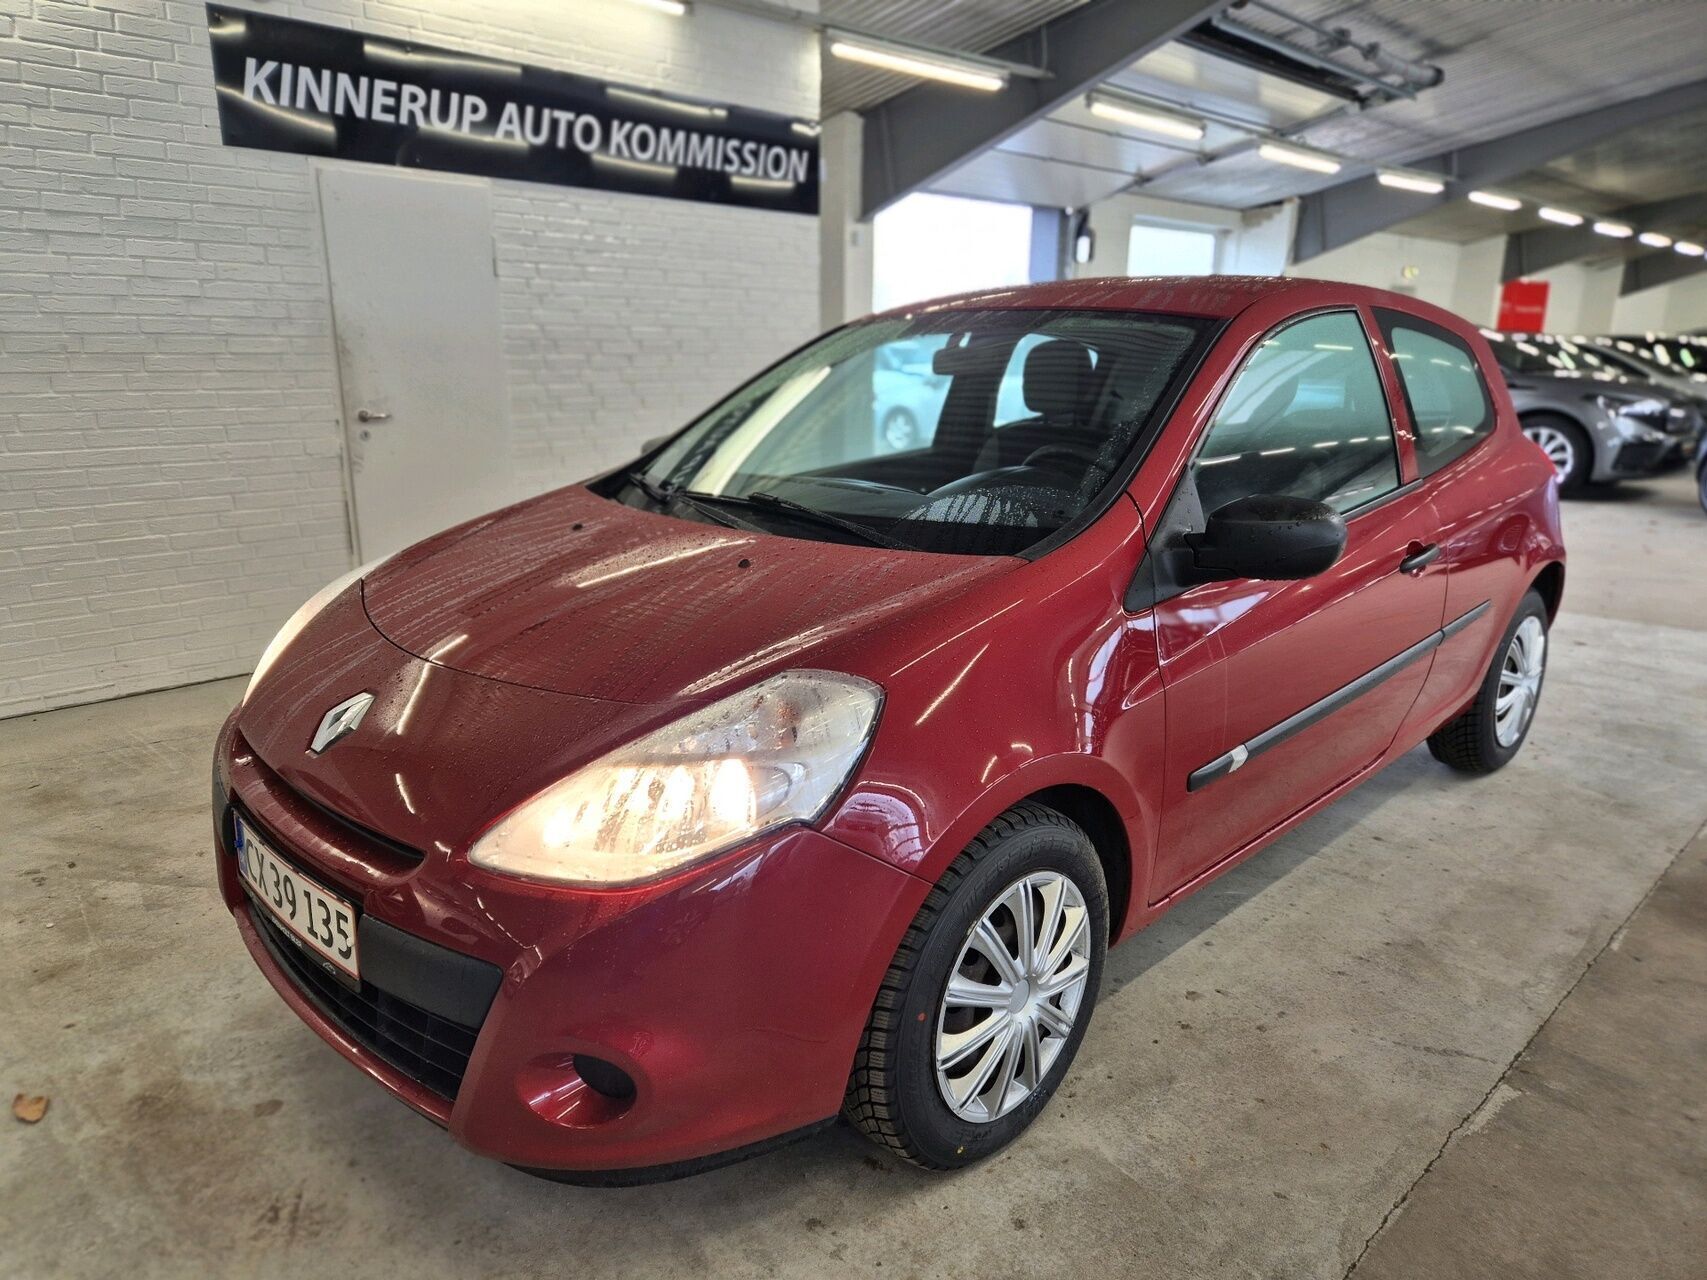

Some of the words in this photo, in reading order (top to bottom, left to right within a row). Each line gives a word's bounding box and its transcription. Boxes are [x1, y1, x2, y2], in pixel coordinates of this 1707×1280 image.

[243, 56, 488, 134] KINNERUP
[494, 101, 601, 152] AUTO
[608, 119, 809, 182] KOMMISSION
[246, 838, 269, 897] CX
[270, 861, 297, 921] 39
[303, 889, 352, 960] 135
